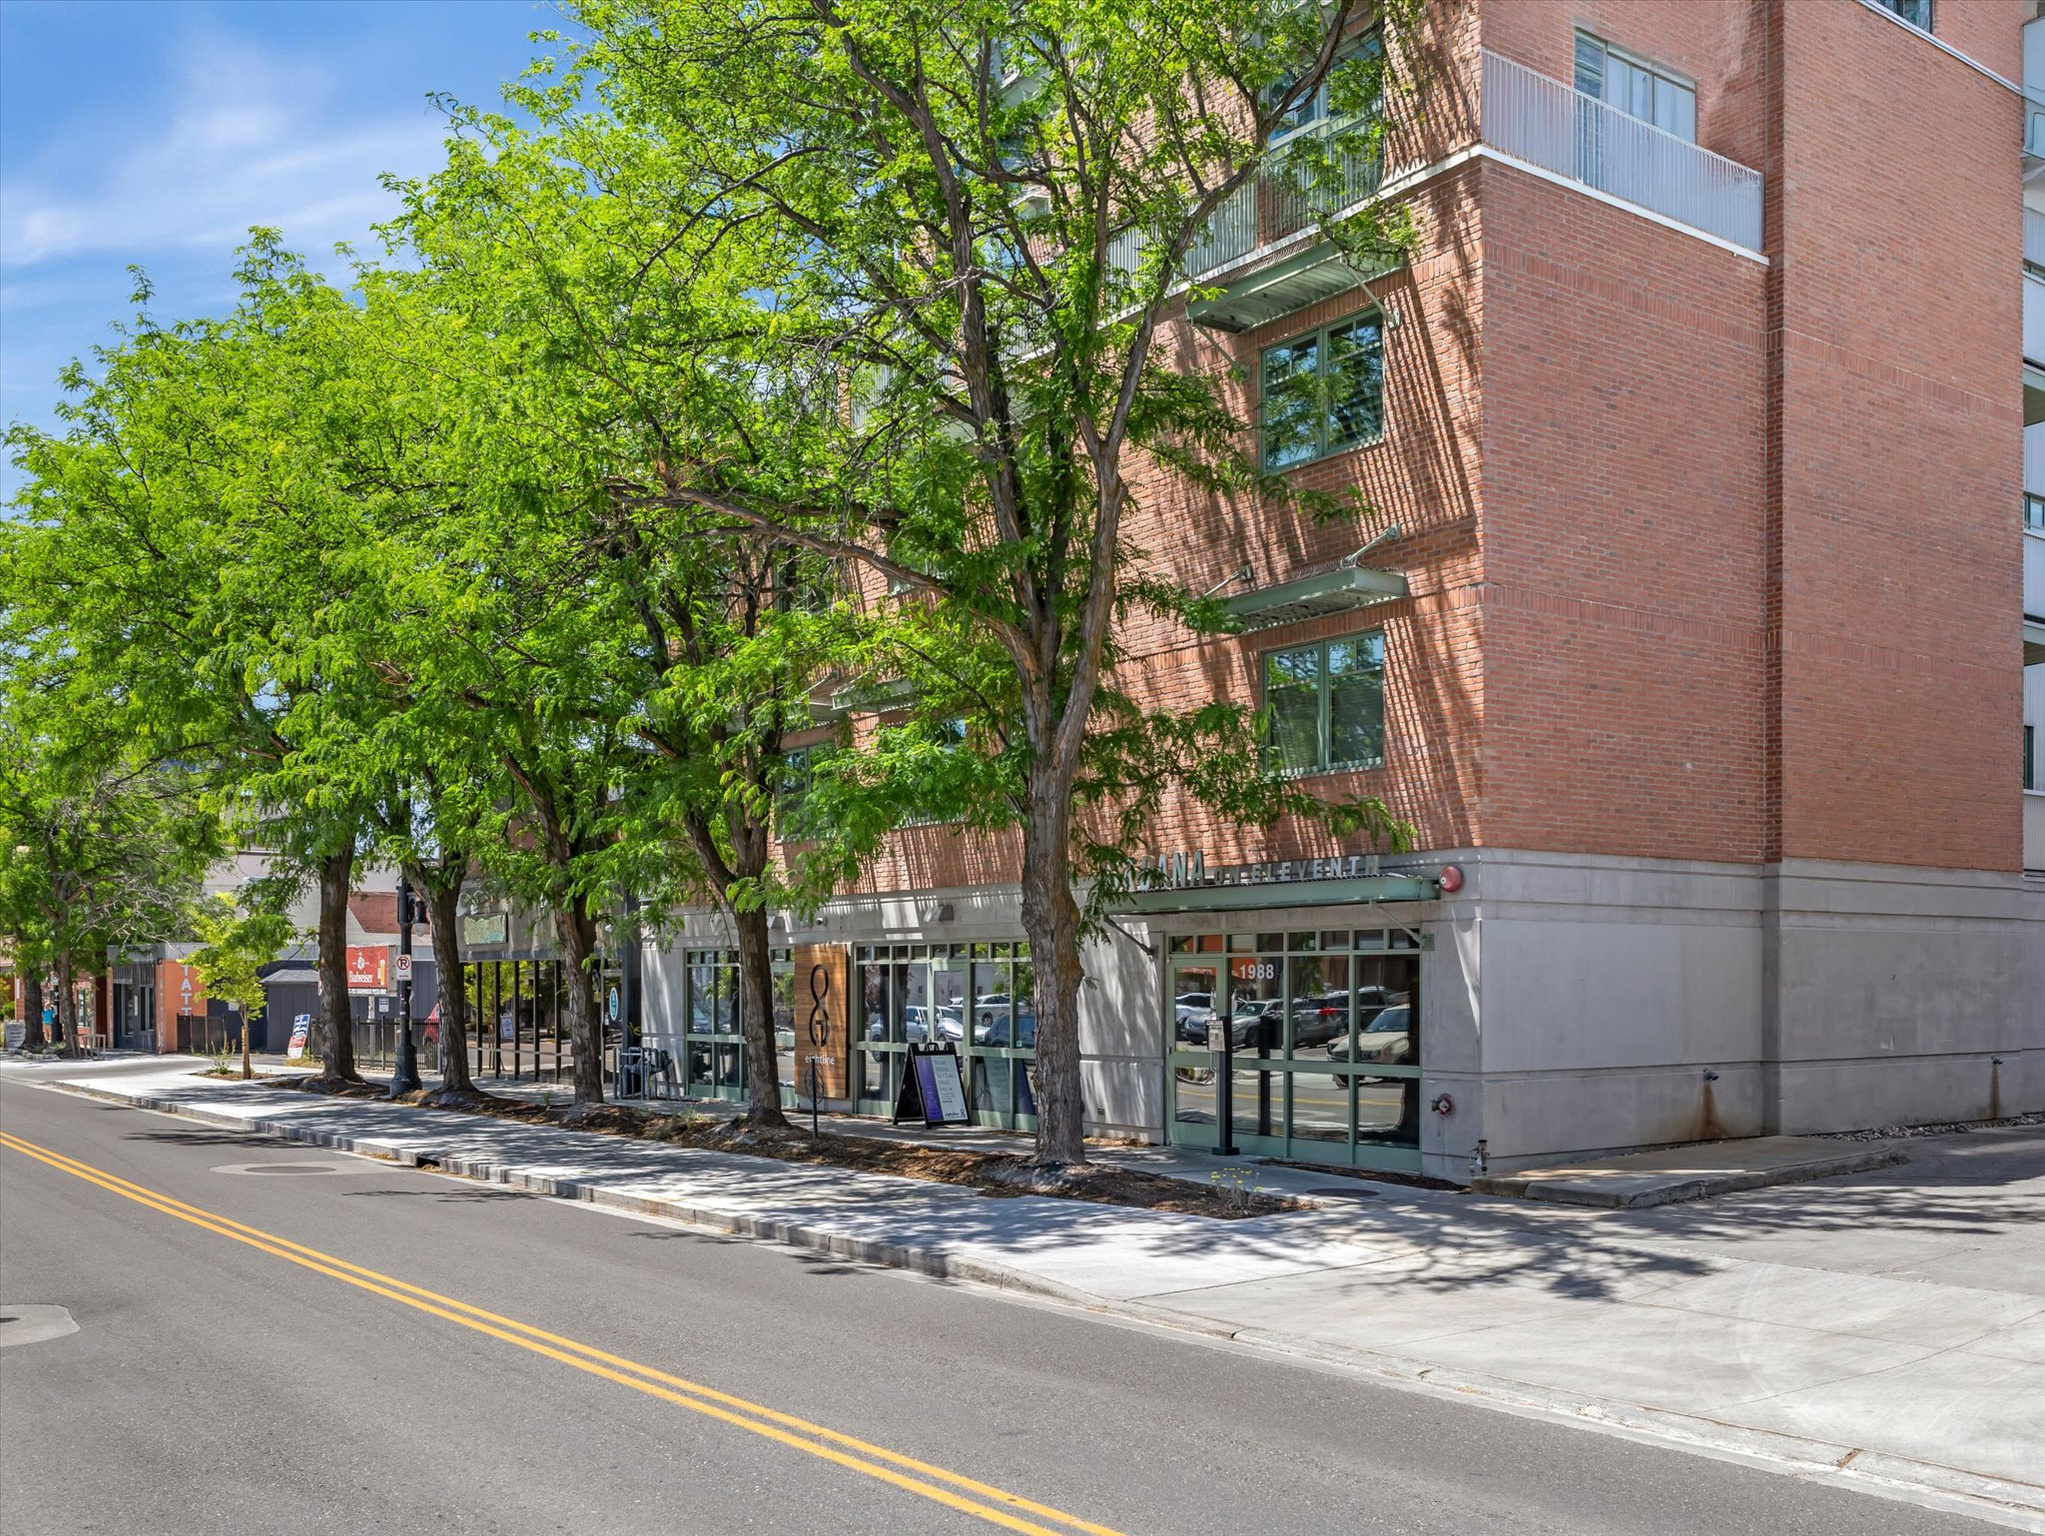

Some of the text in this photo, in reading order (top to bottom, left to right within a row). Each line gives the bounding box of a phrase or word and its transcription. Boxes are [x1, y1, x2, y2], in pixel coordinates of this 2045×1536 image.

[1214, 866, 1241, 885] ON
[1252, 855, 1380, 883] ELEVENTH
[1240, 964, 1275, 980] 1988
